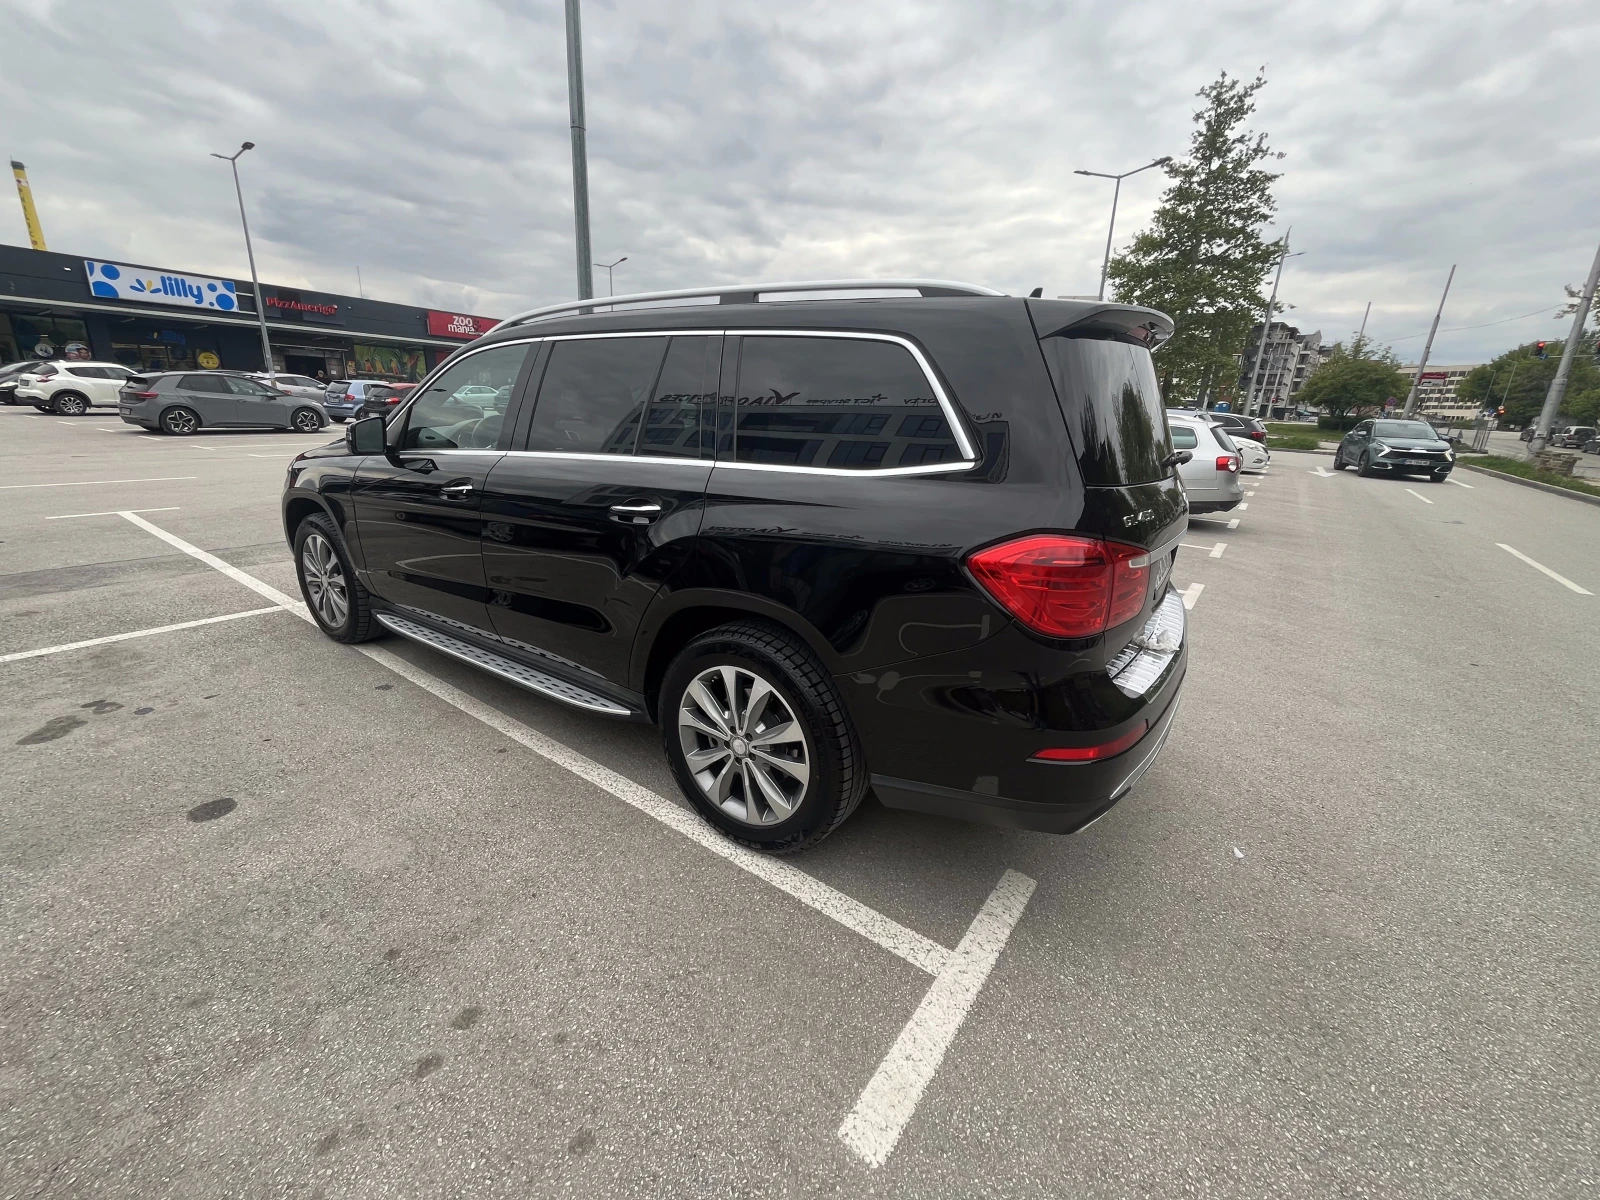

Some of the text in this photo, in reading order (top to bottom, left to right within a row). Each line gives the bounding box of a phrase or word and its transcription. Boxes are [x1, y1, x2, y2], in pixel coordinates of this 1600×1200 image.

[160, 276, 204, 305] lilly
[266, 297, 337, 315] PizzAmerigo
[448, 323, 475, 334] mania
